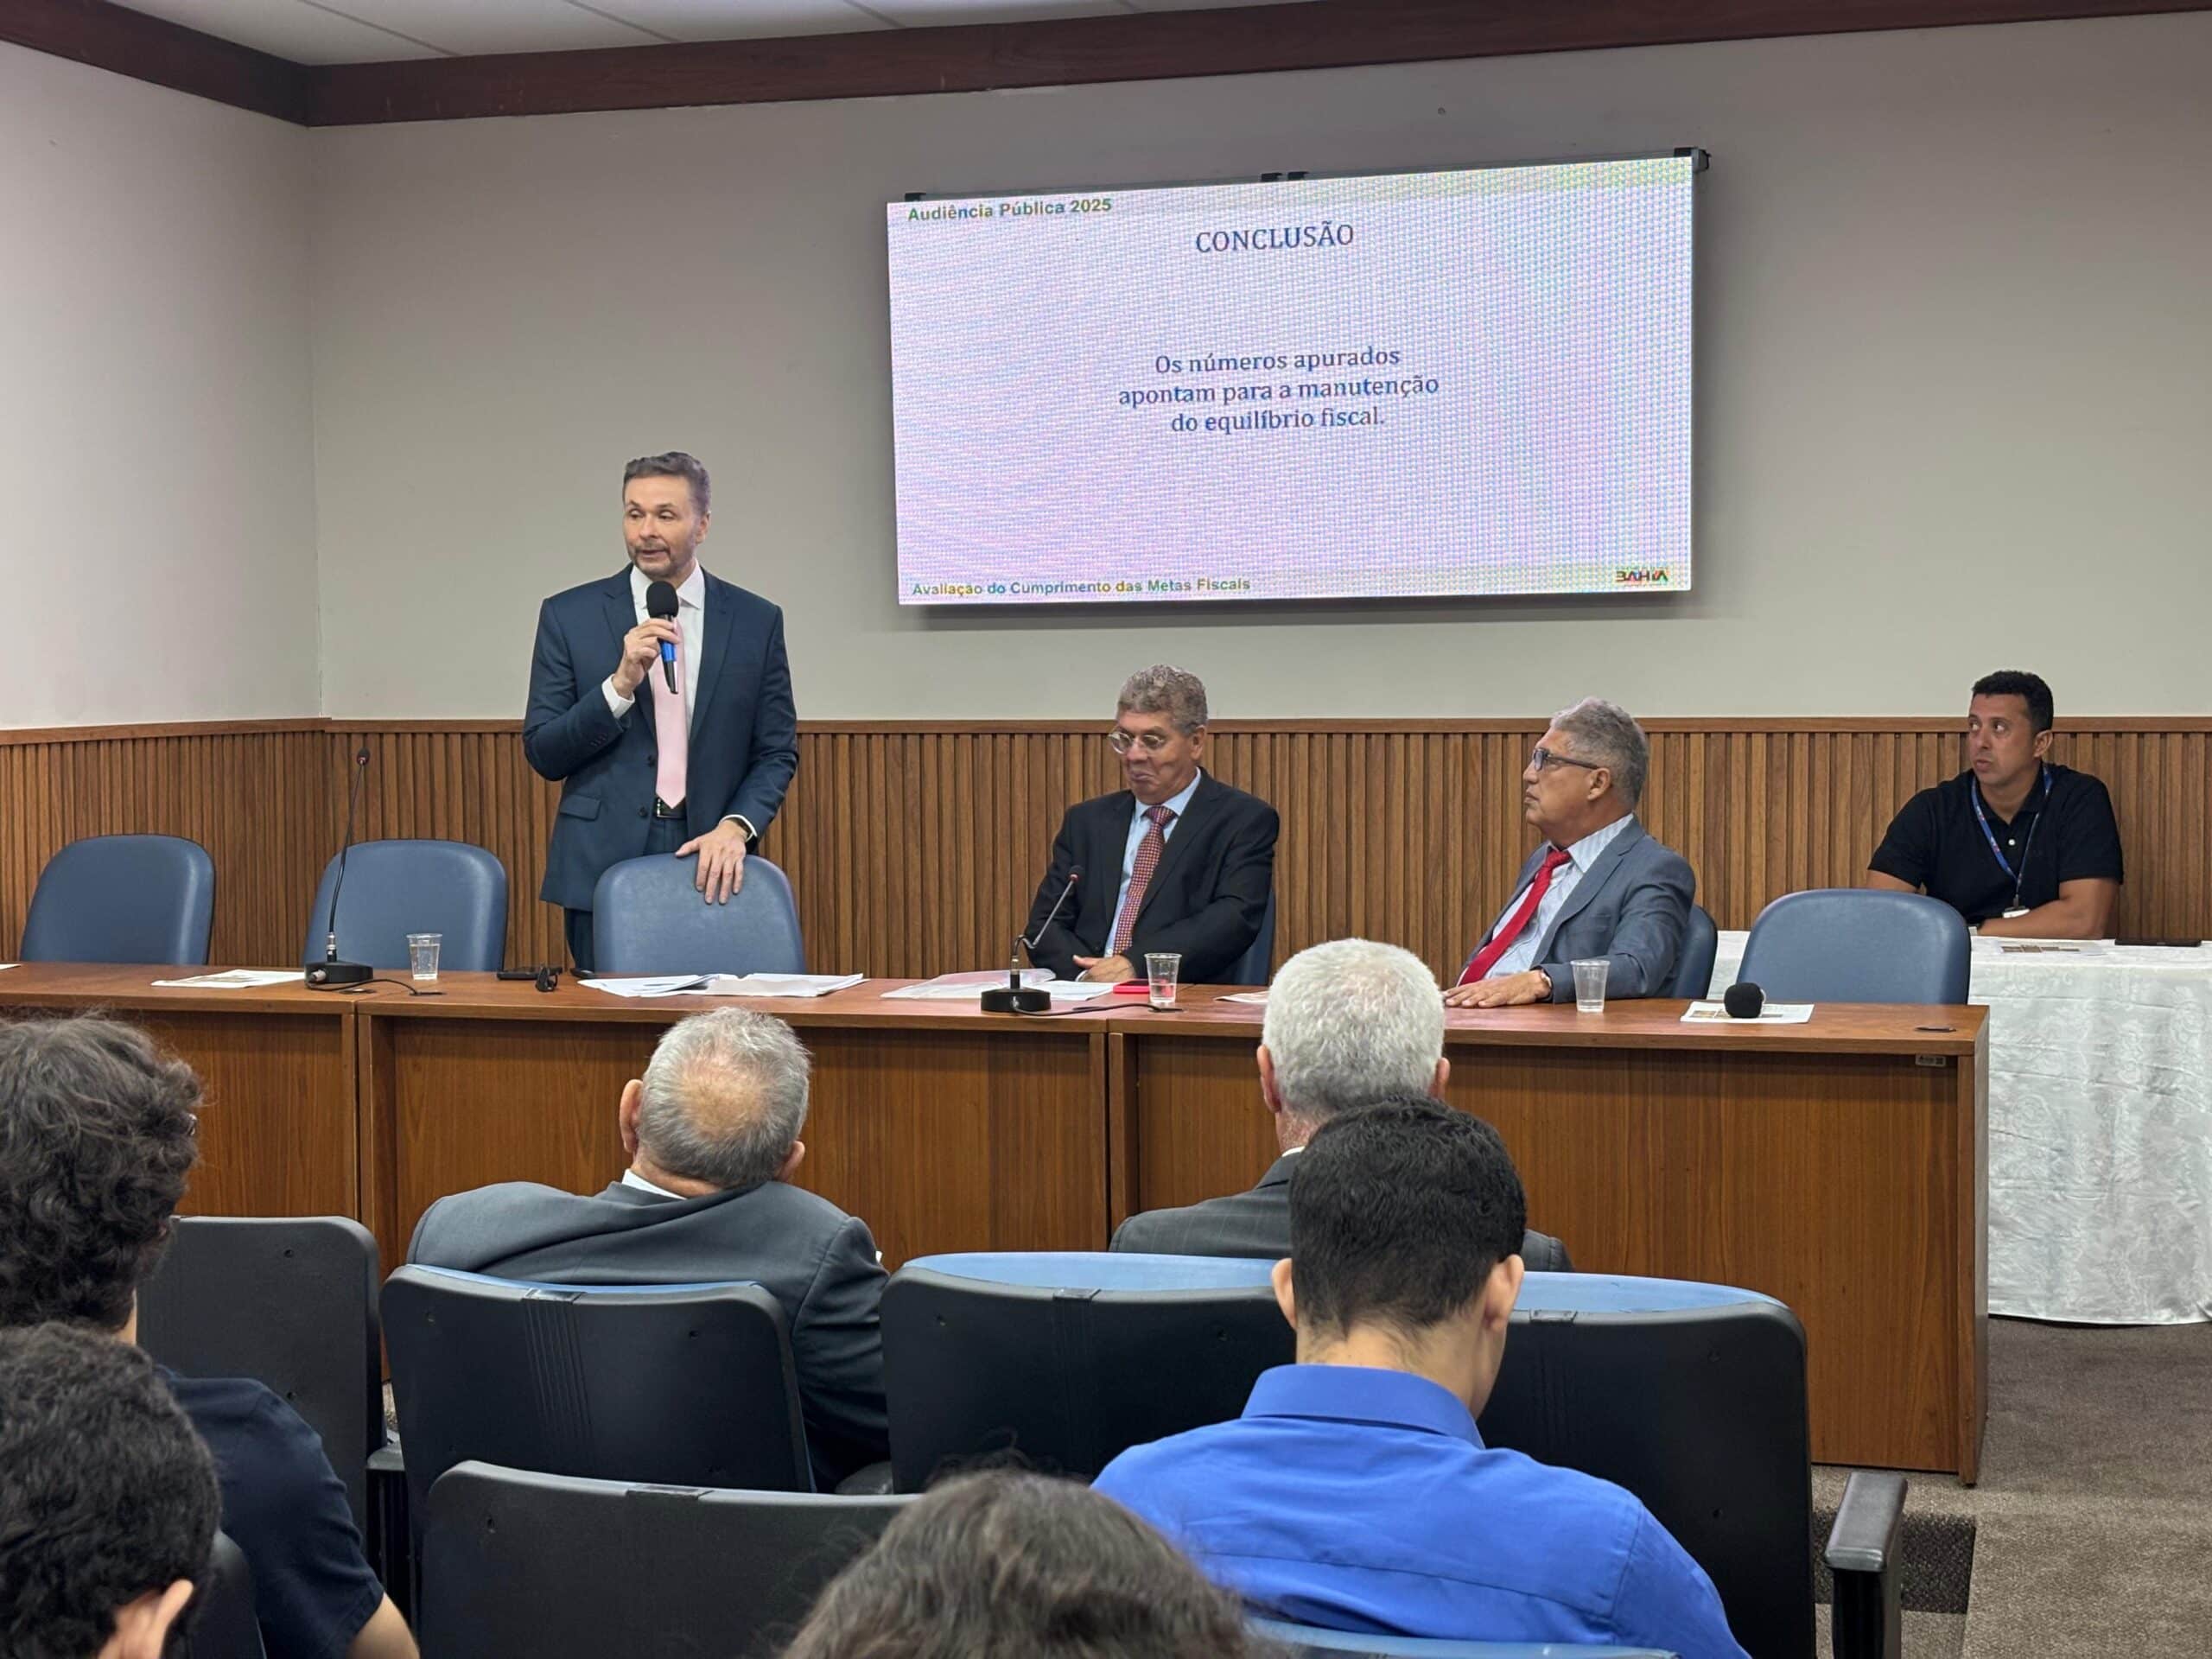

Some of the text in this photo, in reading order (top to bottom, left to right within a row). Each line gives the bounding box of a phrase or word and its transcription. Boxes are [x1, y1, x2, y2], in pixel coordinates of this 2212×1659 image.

[908, 197, 1112, 221] Audiência Pública 2025
[1196, 220, 1354, 253] CONCLUSÃO
[1155, 346, 1401, 373] Os números apurados
[1119, 375, 1440, 409] apontam para a manutenção
[1172, 406, 1384, 435] do equilíbrio fiscal.
[912, 578, 1251, 597] Avaliação do Cumprimento das Metas Fiscais
